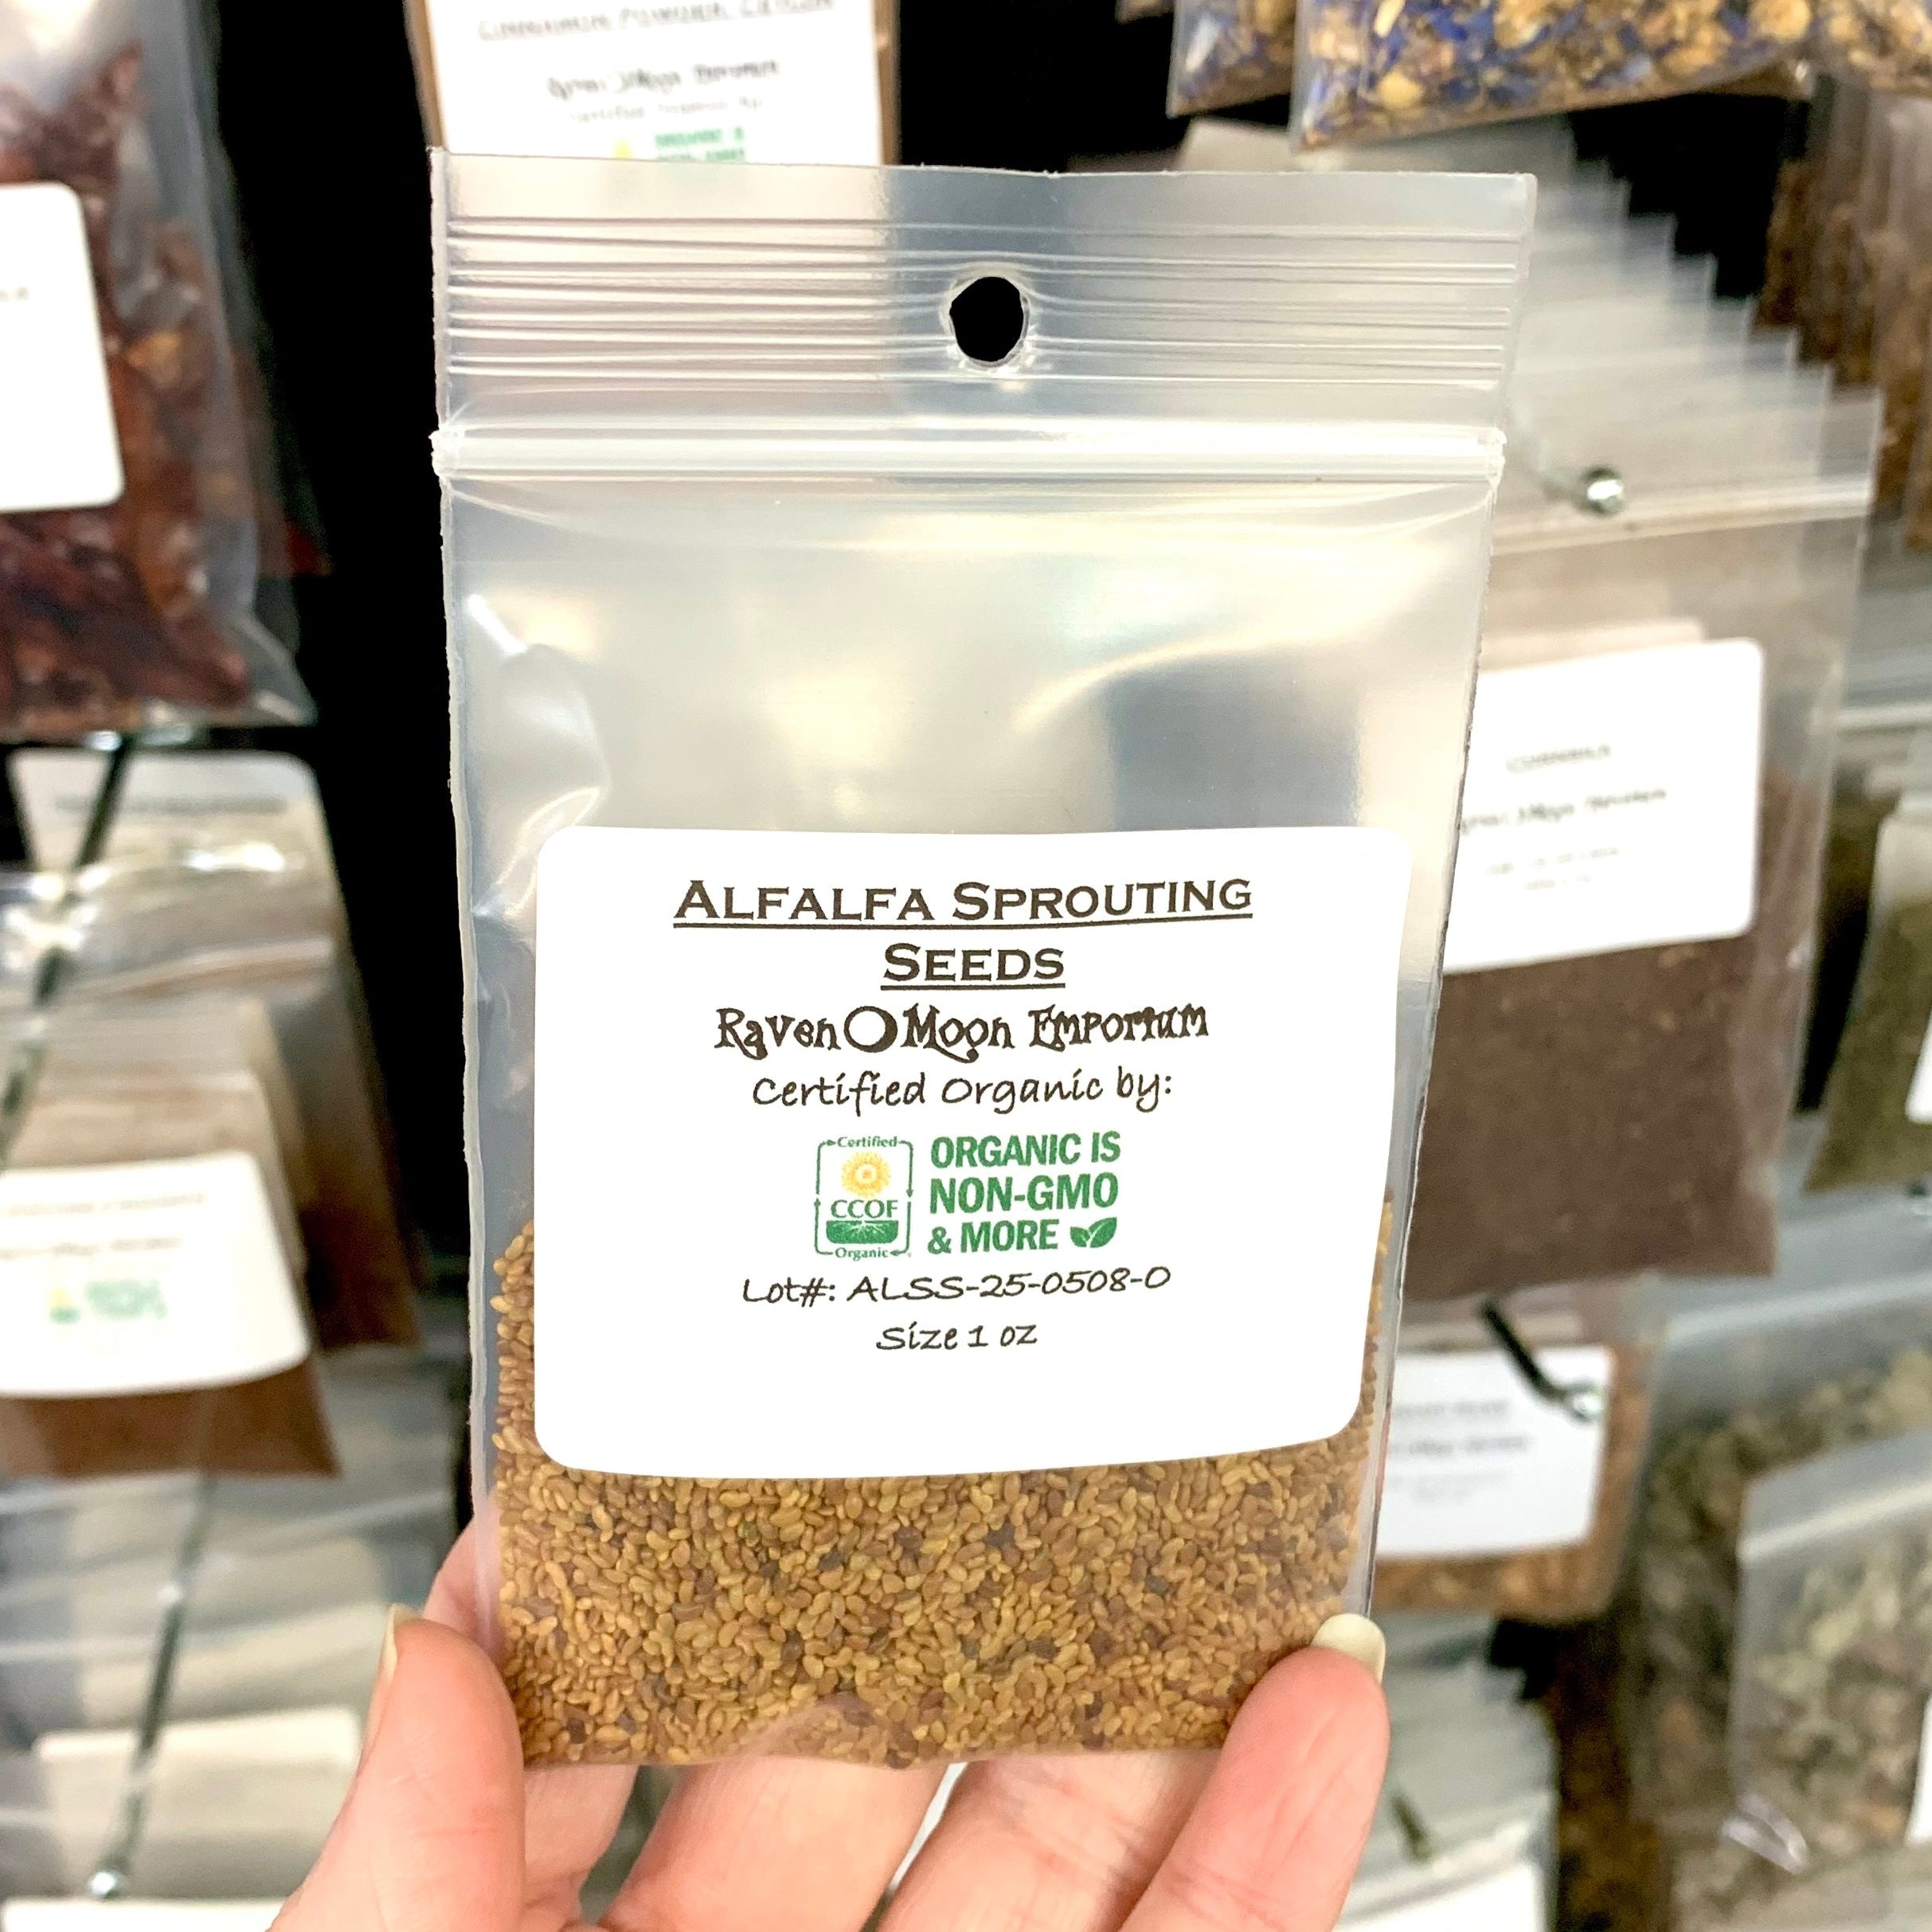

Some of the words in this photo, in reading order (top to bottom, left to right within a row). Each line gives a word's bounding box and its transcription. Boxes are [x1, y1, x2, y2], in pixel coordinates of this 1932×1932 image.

[674, 879, 934, 921] ALFALFA
[952, 878, 1253, 921] SPROUTING
[882, 942, 1066, 982] SEEDS
[752, 1069, 927, 1117] Certified
[941, 1067, 1105, 1115] Organic
[1116, 1064, 1173, 1113] by:
[837, 1136, 898, 1148] Certified
[929, 1132, 1082, 1170] ORGANIC
[1090, 1130, 1122, 1164] IS
[830, 1199, 899, 1219] CCOF
[929, 1171, 1120, 1214] NON-GMO
[835, 1246, 889, 1261] Organic
[926, 1226, 952, 1256] &
[960, 1218, 1060, 1254] MORE
[741, 1276, 837, 1308] Lot#:
[874, 1320, 959, 1351] Size
[967, 1324, 990, 1348] 1
[999, 1324, 1038, 1348] oz
